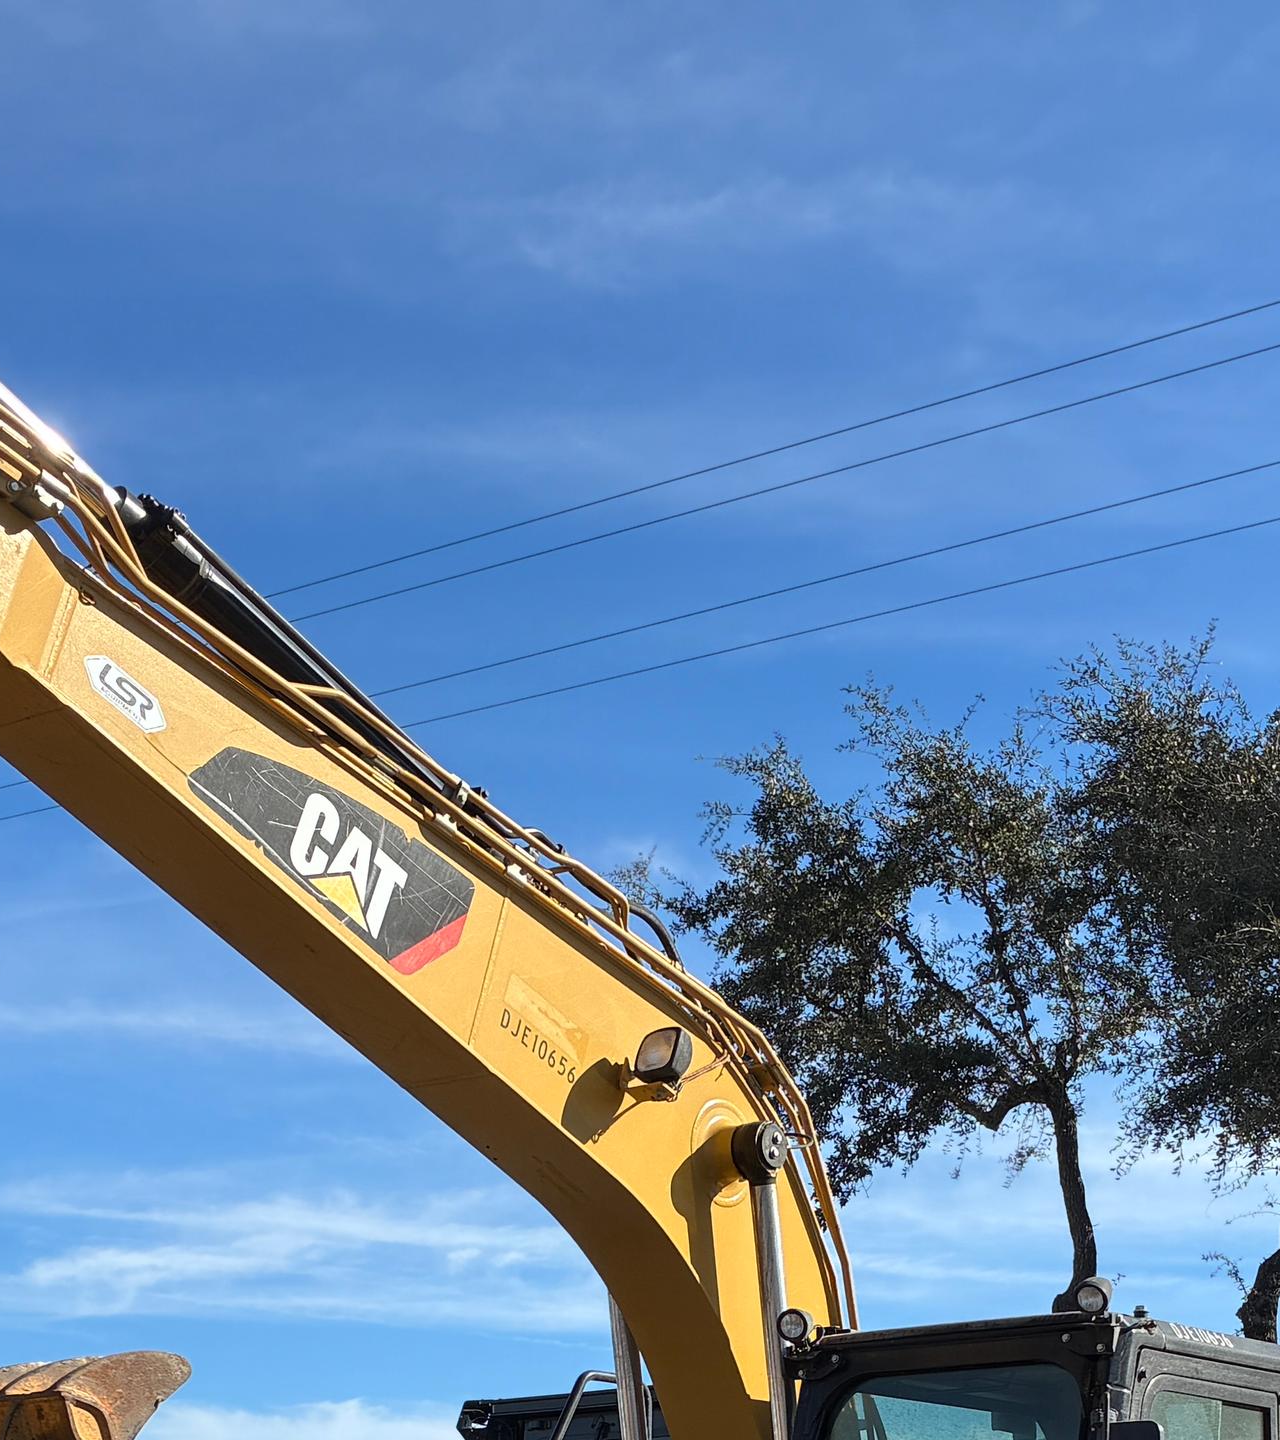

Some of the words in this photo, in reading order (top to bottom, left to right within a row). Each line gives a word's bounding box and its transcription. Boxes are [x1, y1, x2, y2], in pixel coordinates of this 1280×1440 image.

[99, 664, 154, 720] LSR
[290, 793, 408, 940] CAT
[500, 1008, 576, 1084] DJE10656
